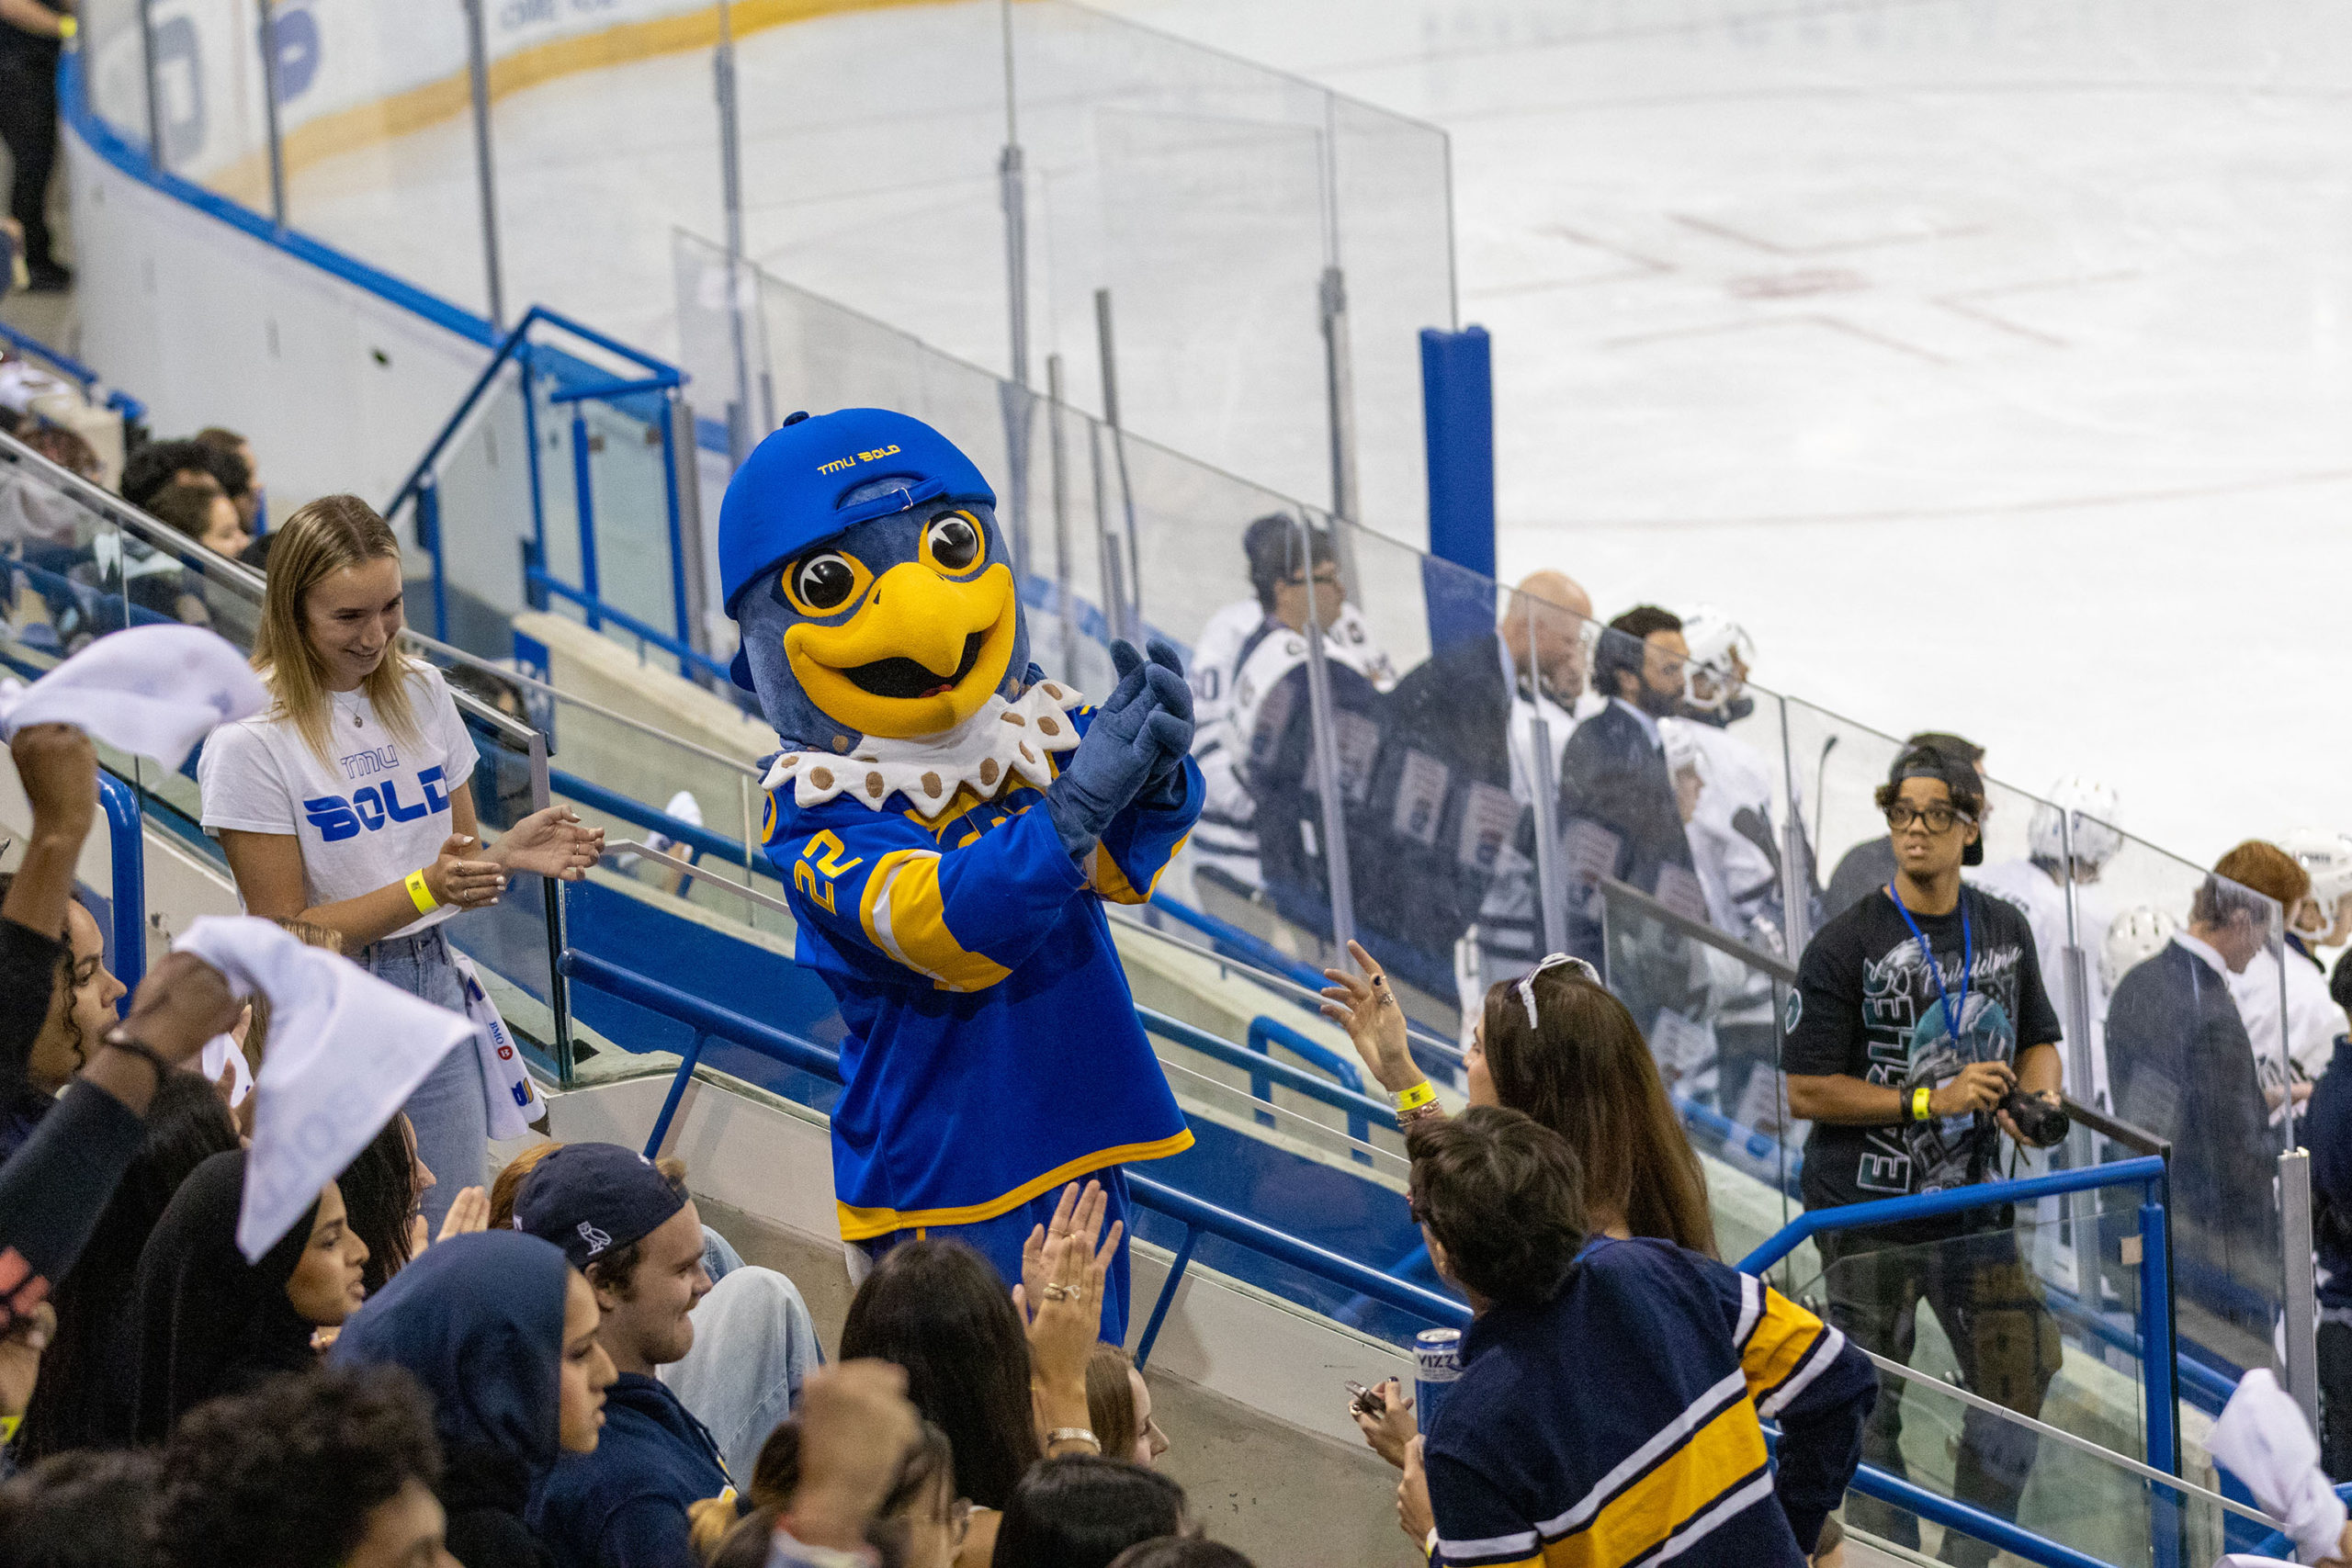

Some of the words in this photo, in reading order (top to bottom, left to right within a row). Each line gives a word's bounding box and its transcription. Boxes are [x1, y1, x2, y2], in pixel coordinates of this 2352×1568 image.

[817, 455, 856, 476] TMU
[857, 444, 901, 462] BOLD
[340, 744, 400, 779] TMU
[303, 765, 450, 842] BOLD
[794, 829, 864, 916] 22
[489, 1021, 504, 1044] BMO
